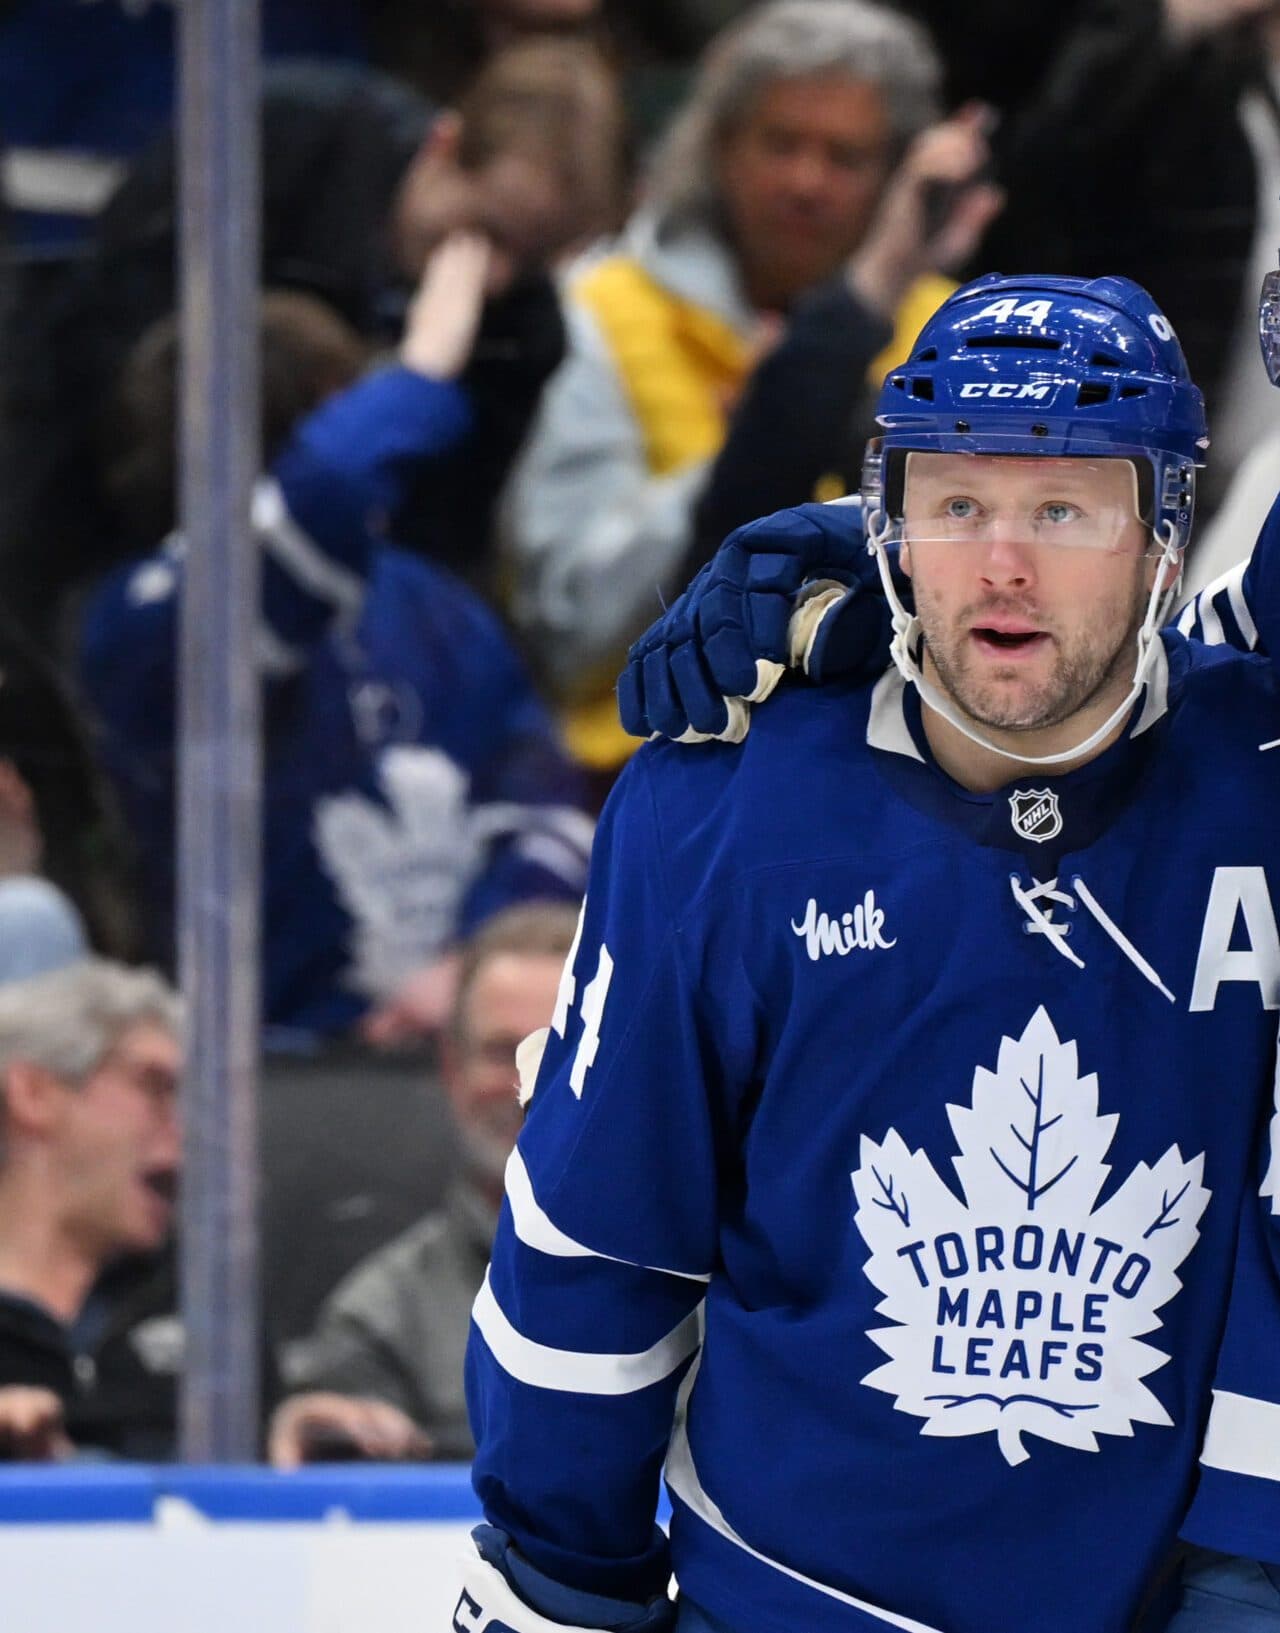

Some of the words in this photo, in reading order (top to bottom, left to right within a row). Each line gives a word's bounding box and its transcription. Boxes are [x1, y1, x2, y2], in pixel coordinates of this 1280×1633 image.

[978, 299, 1053, 327] 44
[960, 383, 1051, 400] CCM
[1021, 803, 1051, 832] NHL
[790, 889, 897, 961] Milk
[1188, 866, 1280, 1012] A
[896, 1224, 1151, 1299] TORONTO
[936, 1286, 1109, 1333] MAPLE
[931, 1335, 1104, 1382] LEAFS
